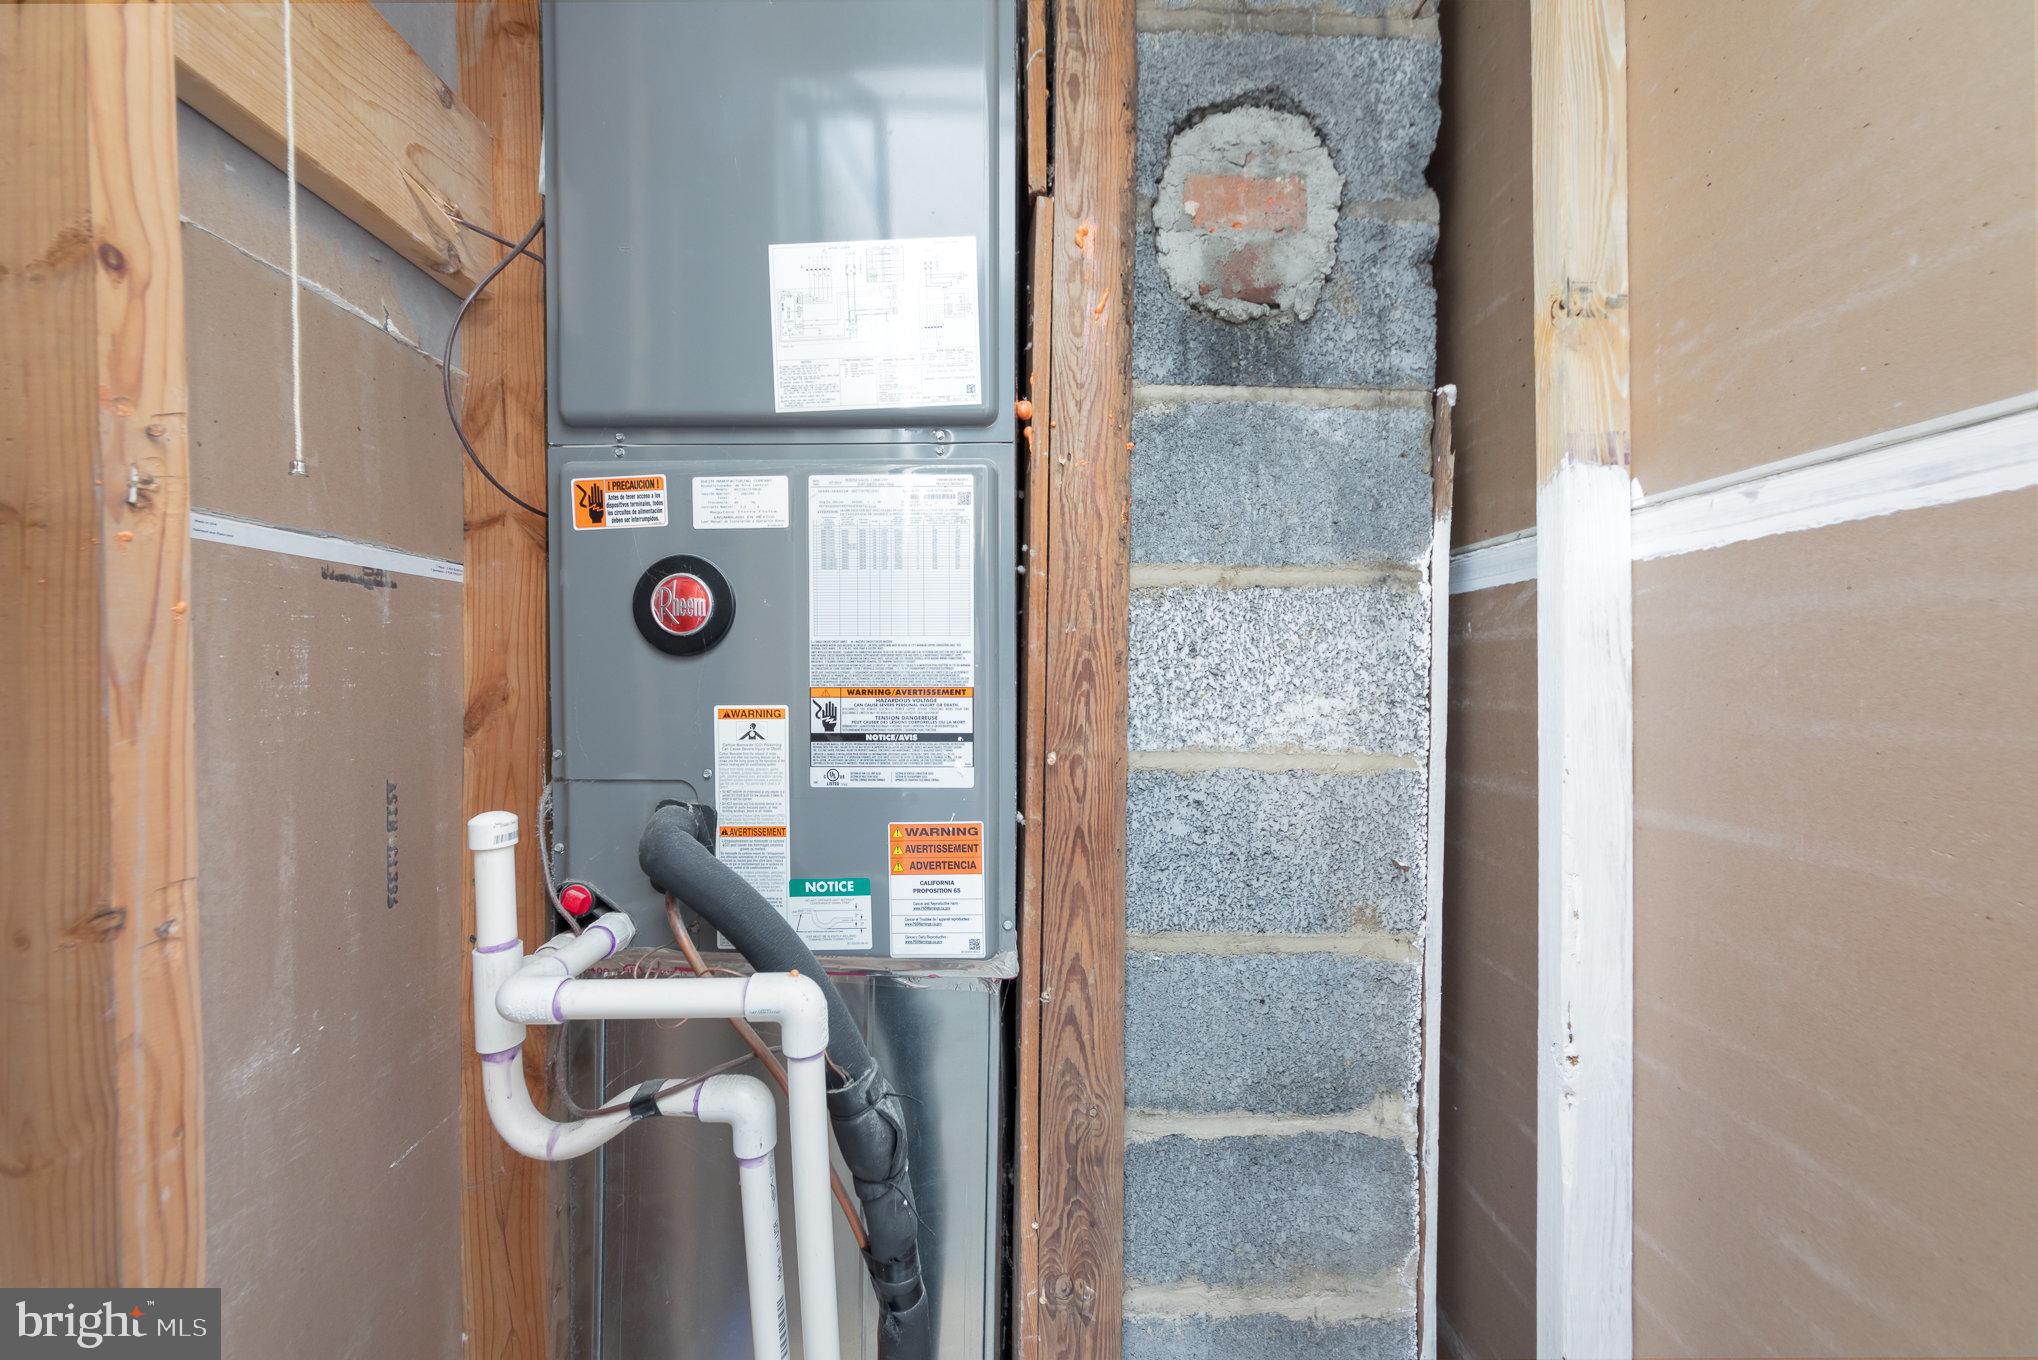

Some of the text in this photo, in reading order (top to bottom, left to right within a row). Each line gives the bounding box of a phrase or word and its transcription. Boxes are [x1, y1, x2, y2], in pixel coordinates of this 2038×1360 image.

[612, 479, 655, 490] PRECAUCION
[658, 580, 706, 624] Rheem
[731, 710, 781, 719] WARNING
[730, 827, 787, 836] AVERTISSEMENT
[905, 827, 979, 837] WARNING
[905, 843, 979, 854] AVERTISSEMENT
[909, 860, 977, 870] ADVERTENCIA
[805, 880, 854, 893] NOTICE
